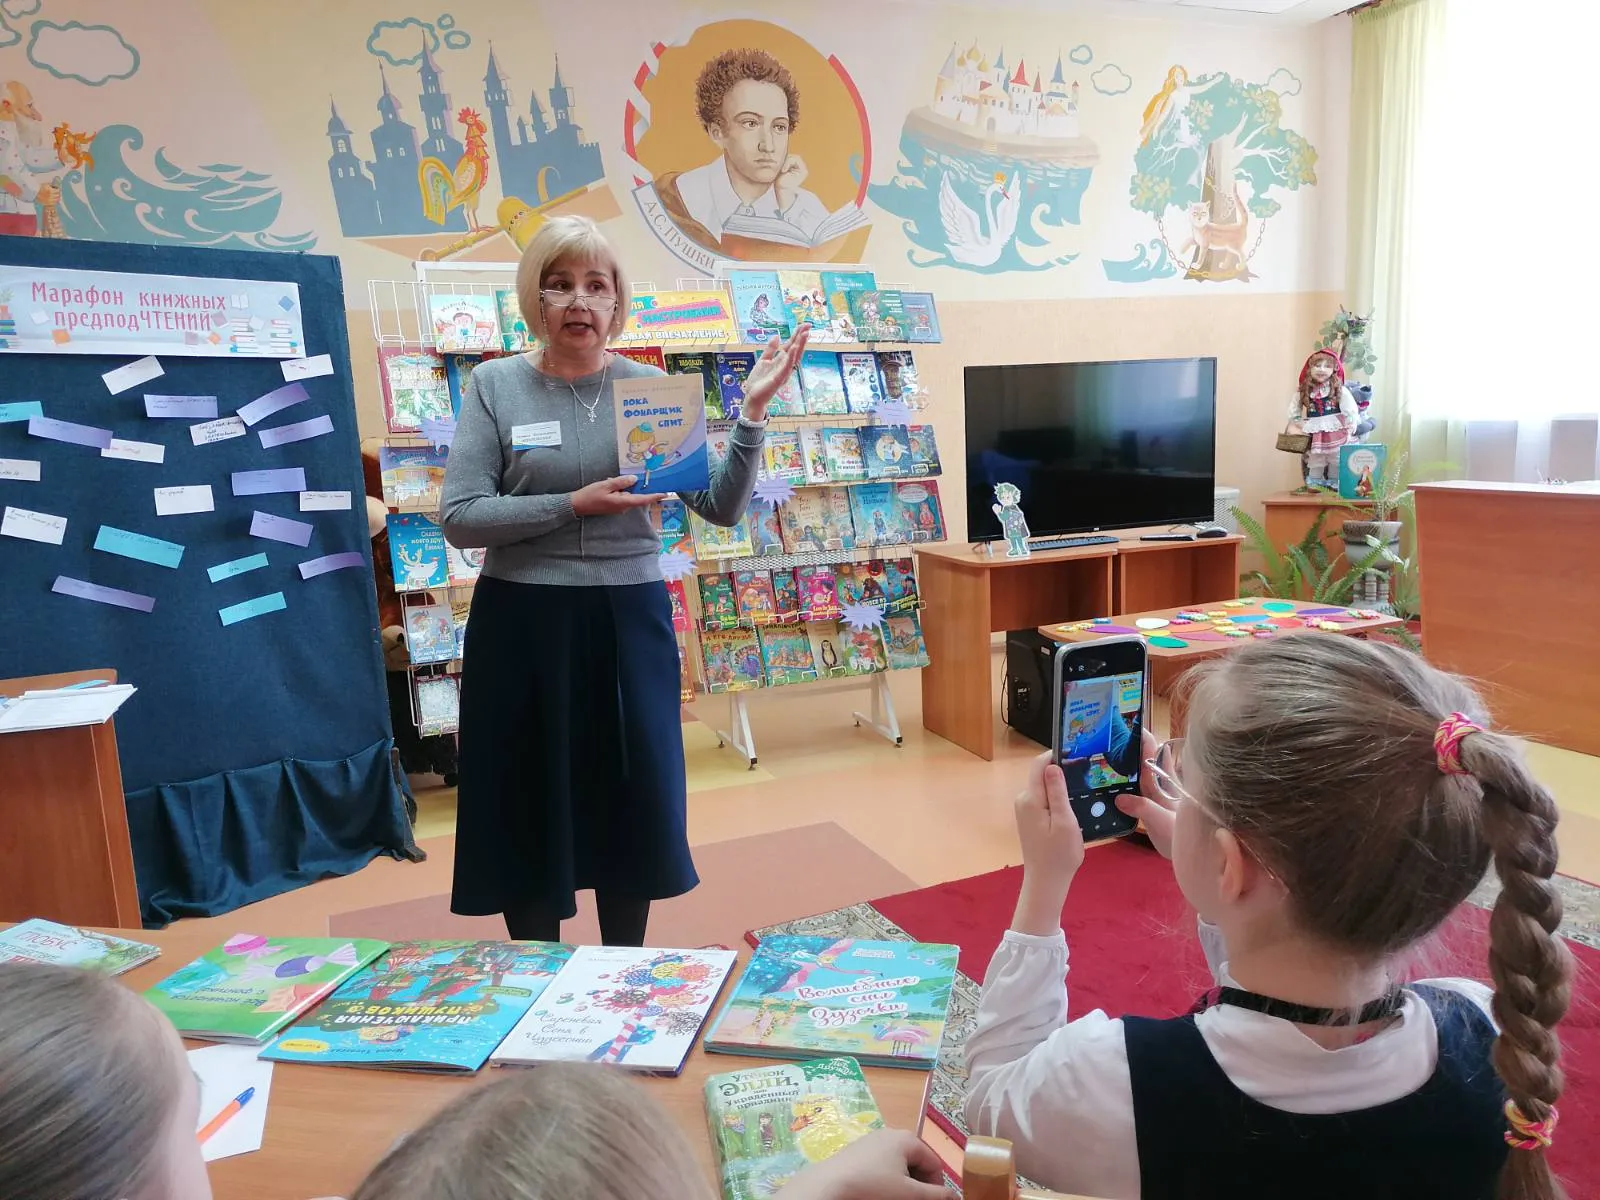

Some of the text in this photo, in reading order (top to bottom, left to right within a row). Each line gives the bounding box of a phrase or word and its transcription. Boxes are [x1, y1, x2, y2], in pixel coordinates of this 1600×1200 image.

[664, 226, 717, 270] ПУШКИ
[32, 281, 226, 310] Марафон книжных
[623, 397, 649, 407] ПОКА
[623, 406, 683, 418] ФОНАРЩИК
[798, 977, 918, 999] Волшебные
[850, 992, 894, 1003] сны
[365, 1004, 462, 1015] ПУШИКОВ
[811, 1003, 905, 1027] Зузочки
[334, 1014, 472, 1025] ПРИКЛЮЧЕНИЯ
[736, 1097, 793, 1111] праздник
